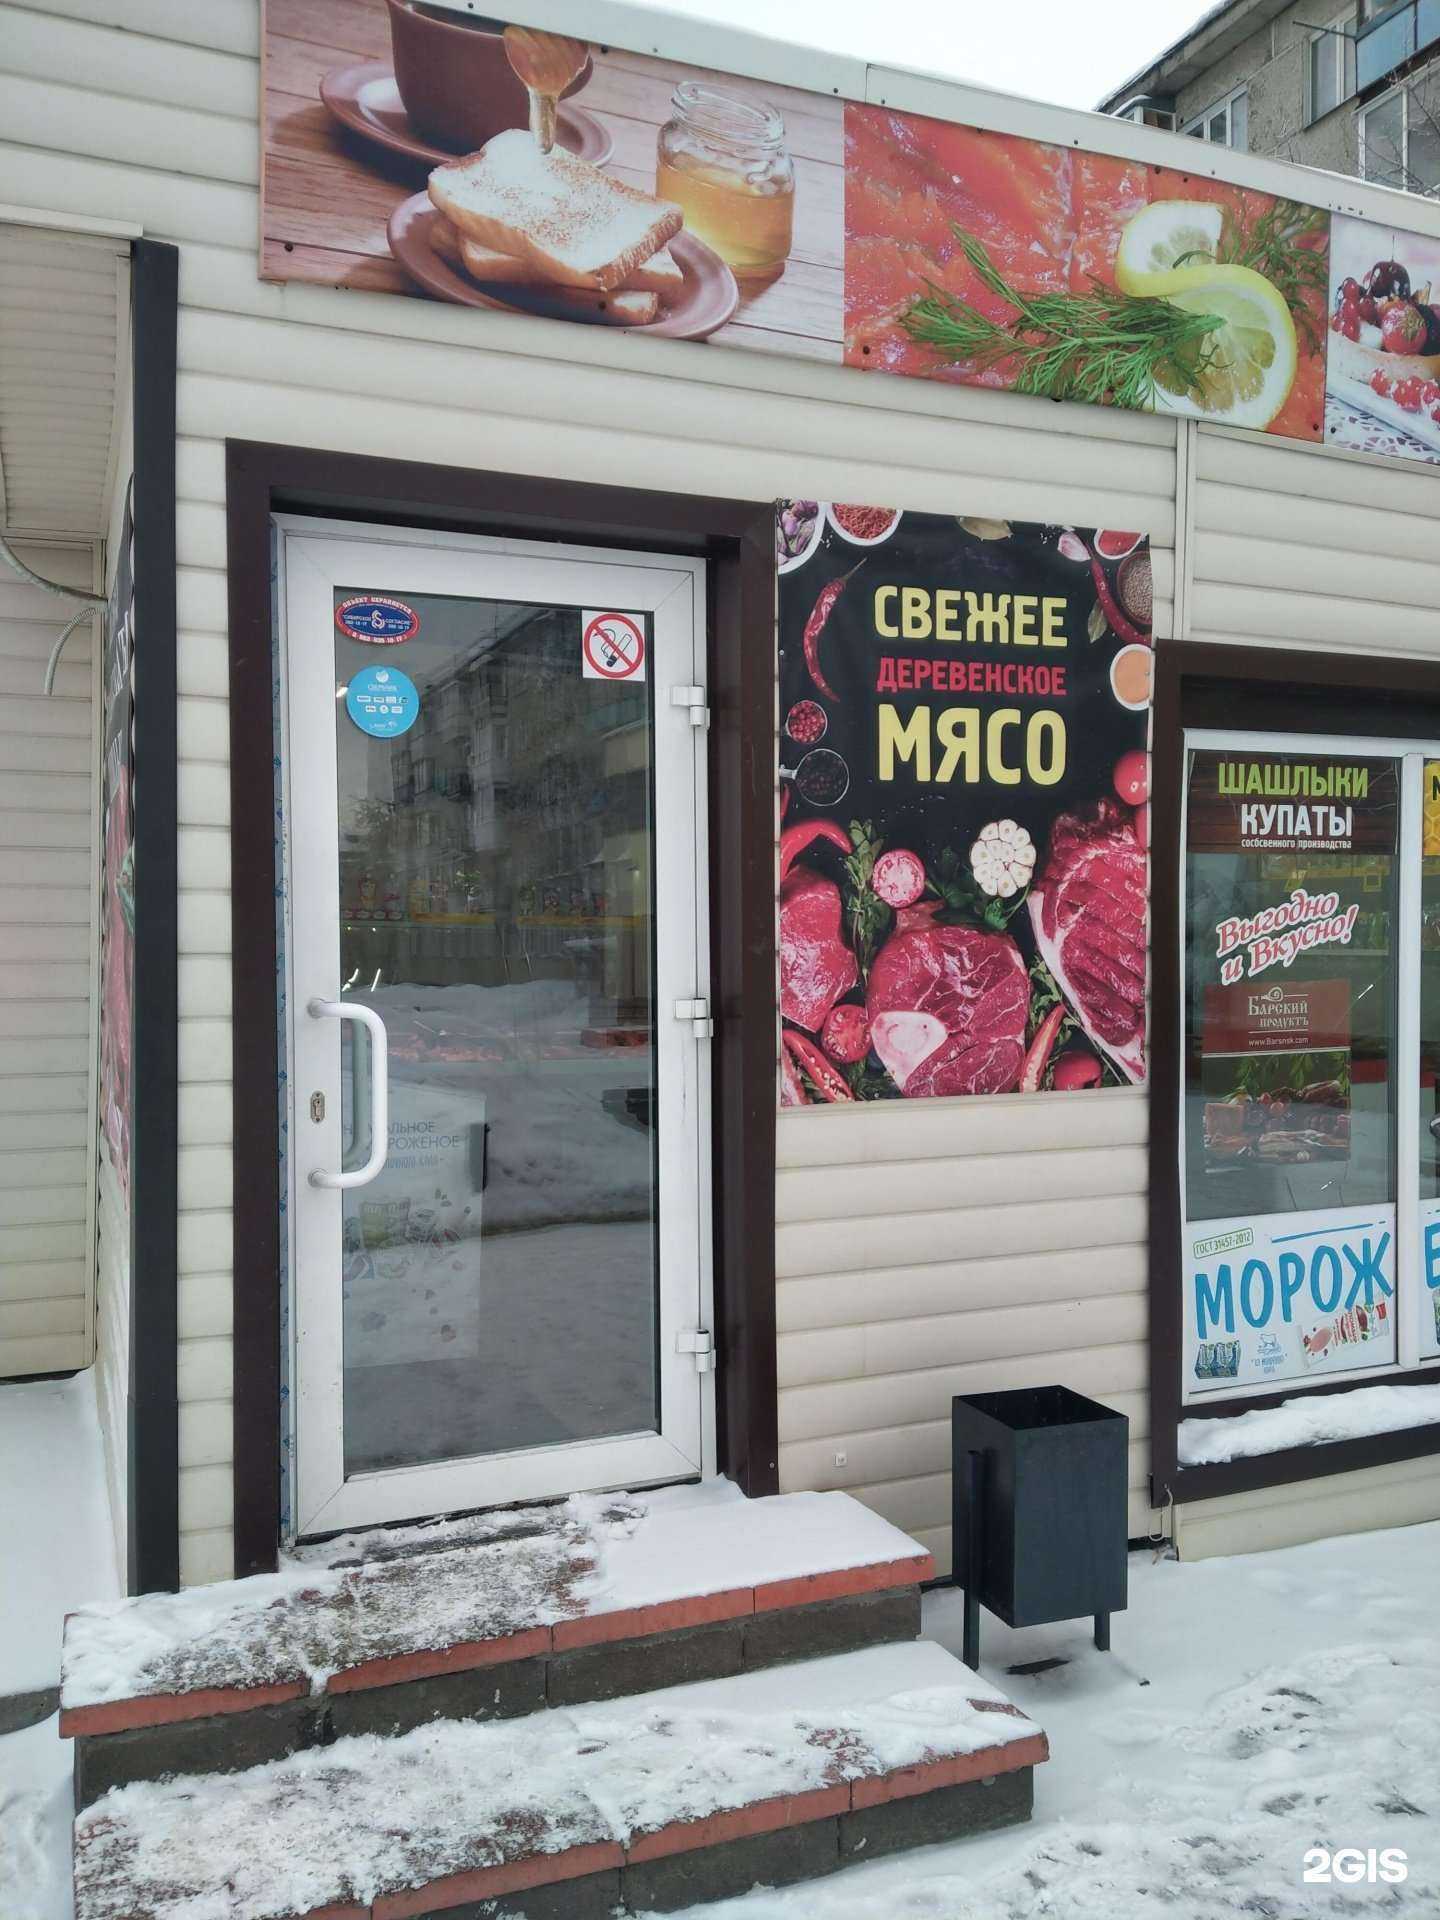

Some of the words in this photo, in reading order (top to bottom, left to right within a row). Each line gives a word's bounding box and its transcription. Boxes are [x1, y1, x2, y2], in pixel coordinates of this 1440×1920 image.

[874, 585, 1068, 647] СВЕЖЕЕ
[875, 656, 1068, 696] ДЕРЕВЕНСКОЕ
[878, 703, 1067, 786] МЯСО
[1218, 762, 1369, 798] ШАШЛЫКИ
[1240, 803, 1353, 837] КУПАТЫ
[1298, 839, 1352, 850] производства
[1217, 890, 1339, 956] Выгодно
[1221, 955, 1243, 984] и
[1248, 904, 1359, 976] Вкусно!
[1195, 1241, 1213, 1255] ГОСТ
[1194, 1231, 1394, 1340] МОРОЖ
